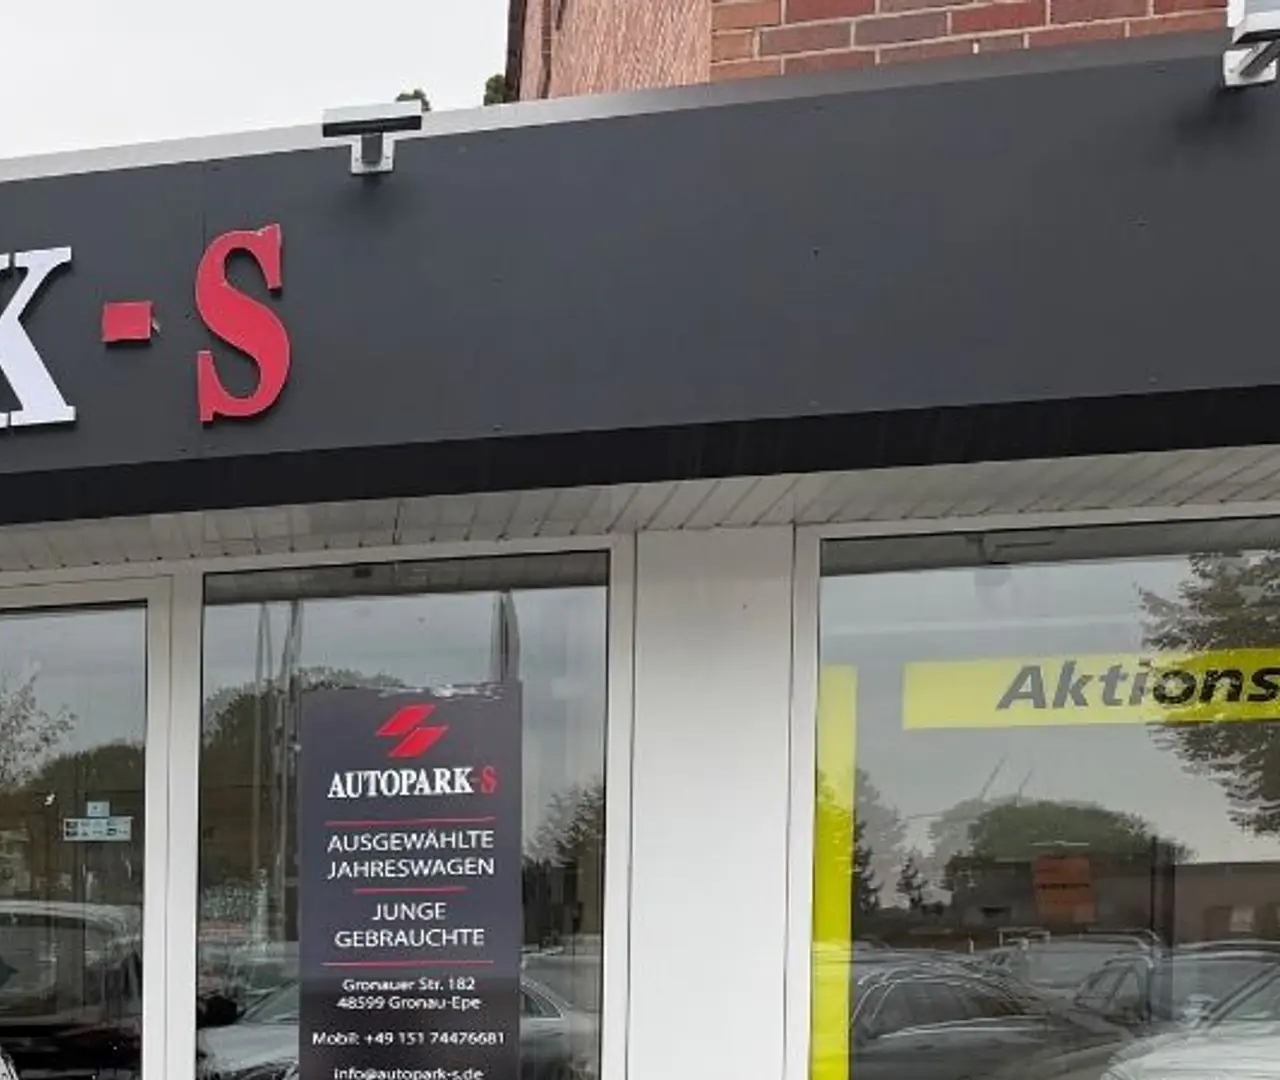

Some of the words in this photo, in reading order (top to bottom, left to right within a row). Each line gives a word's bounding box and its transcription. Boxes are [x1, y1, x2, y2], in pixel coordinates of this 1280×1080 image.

[995, 659, 1280, 710] Aktions
[328, 765, 497, 798] AUTOPARK-S
[327, 830, 494, 853] AUSGEWÄHLTE
[327, 857, 494, 879] JAHRESWAGEN
[372, 902, 446, 921] JUNGE
[335, 929, 484, 948] GEBRAUCHTE
[342, 979, 414, 992] Gronauer
[420, 977, 444, 991] Str.
[448, 976, 476, 991] 182
[336, 996, 385, 1010] 48599
[388, 995, 482, 1012] Gronau-Epe
[364, 1032, 394, 1045] +49
[398, 1032, 424, 1045] 151
[430, 1032, 505, 1045] 74476681
